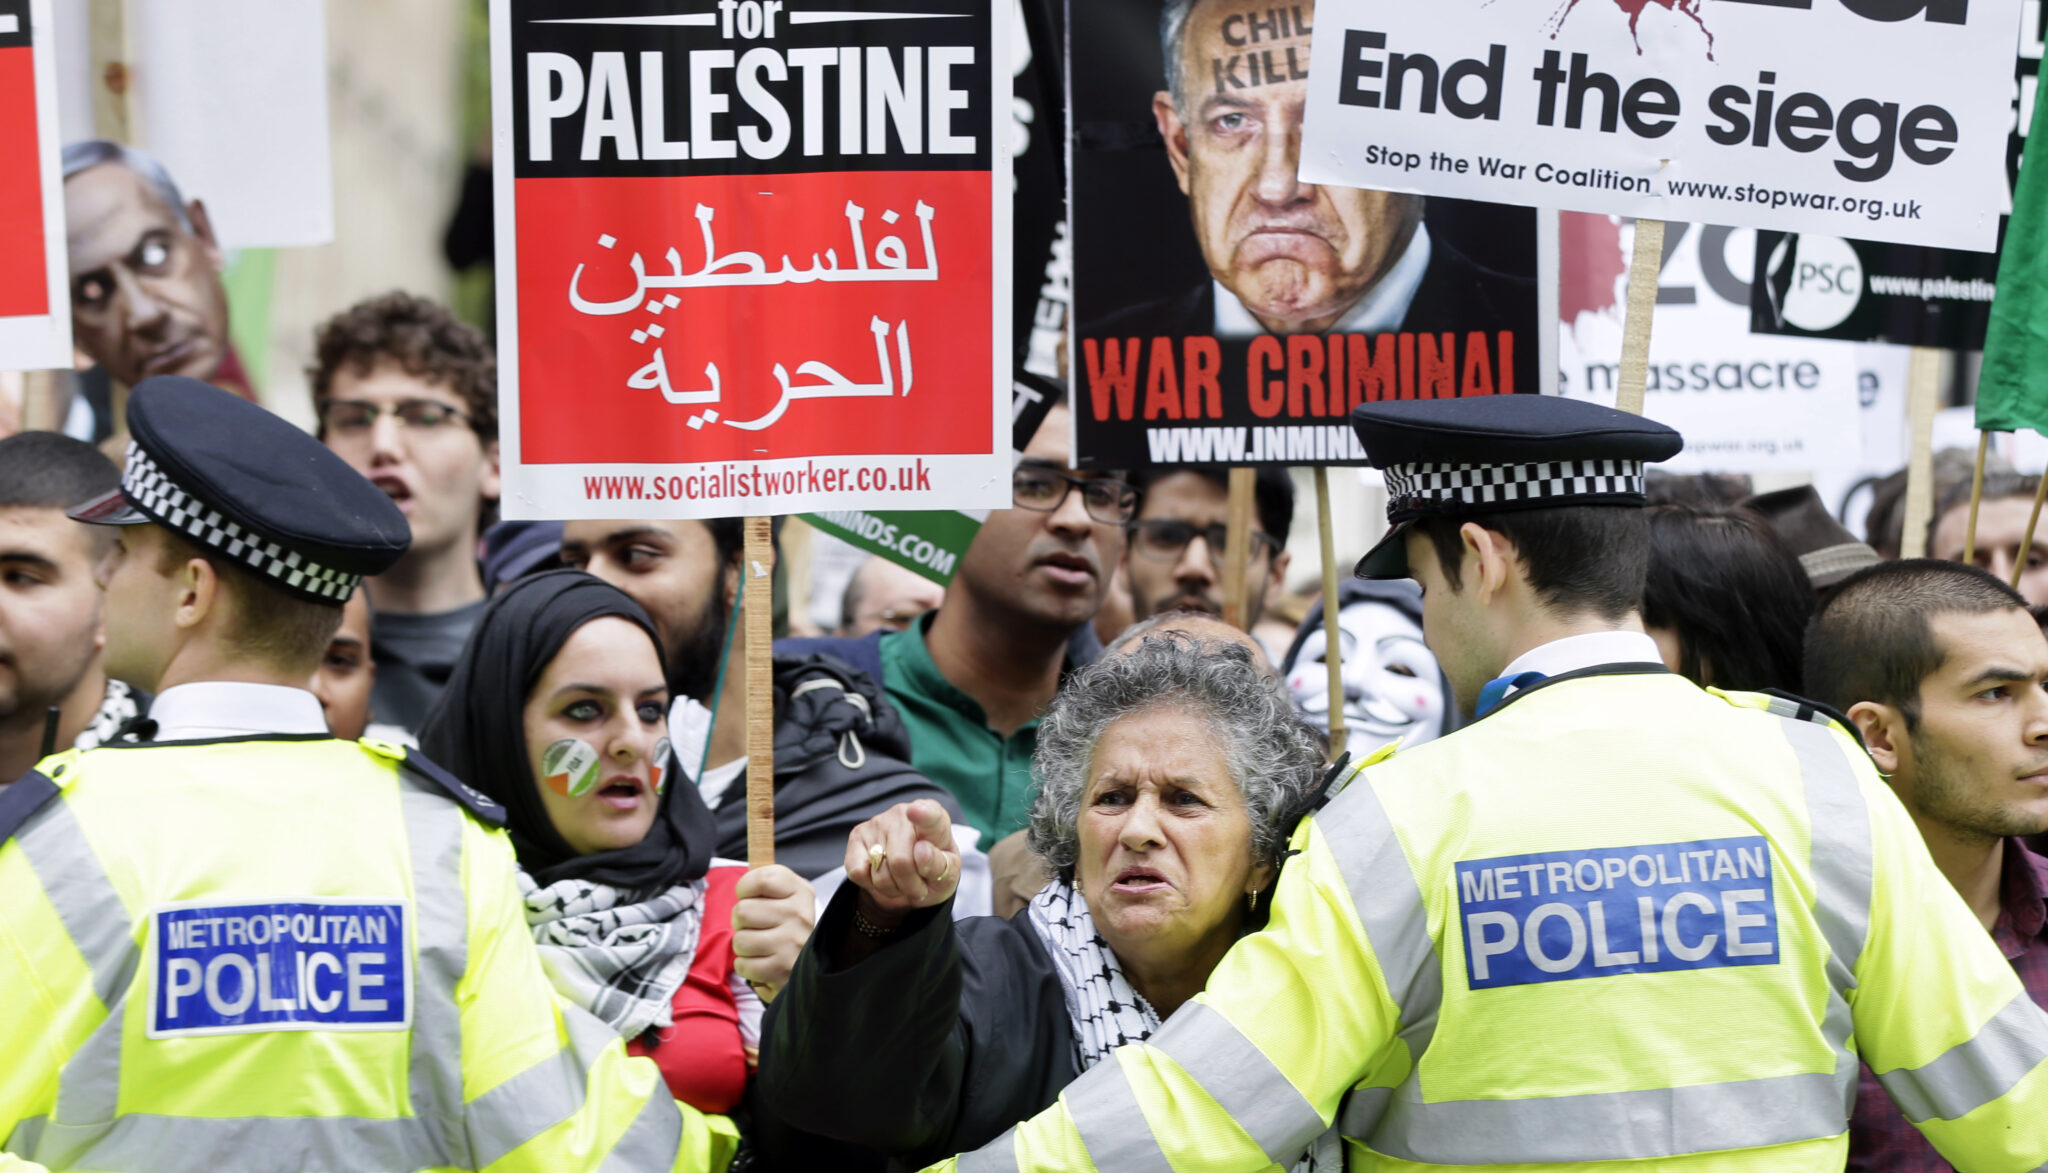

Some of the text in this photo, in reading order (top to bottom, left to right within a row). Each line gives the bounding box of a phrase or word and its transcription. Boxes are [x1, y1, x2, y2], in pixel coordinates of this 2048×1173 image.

[717, 0, 783, 39] for
[1222, 5, 1313, 47] CHIL
[1212, 47, 1308, 93] KILL
[526, 46, 977, 161] PALESTINE
[1339, 29, 1507, 121] End
[1533, 49, 1680, 139] the
[1705, 70, 1958, 182] siege
[1366, 145, 1922, 220] Stop the War Coalition www.stopwar.org.uk
[568, 200, 939, 315] لفلسطين
[1799, 262, 1996, 301] PSC www.palestin
[627, 315, 914, 431] الحرية
[1083, 336, 1223, 421] WAR
[1147, 425, 1369, 463] WWW.INMIND
[583, 458, 931, 500] www.socialistworker.co.uk
[814, 511, 957, 576] MINDS.COM
[1461, 847, 1766, 903] METROPOLITAN
[168, 914, 387, 949] METROPOLITAN
[1467, 888, 1773, 981] POLICE
[166, 951, 388, 1019] POLICE
